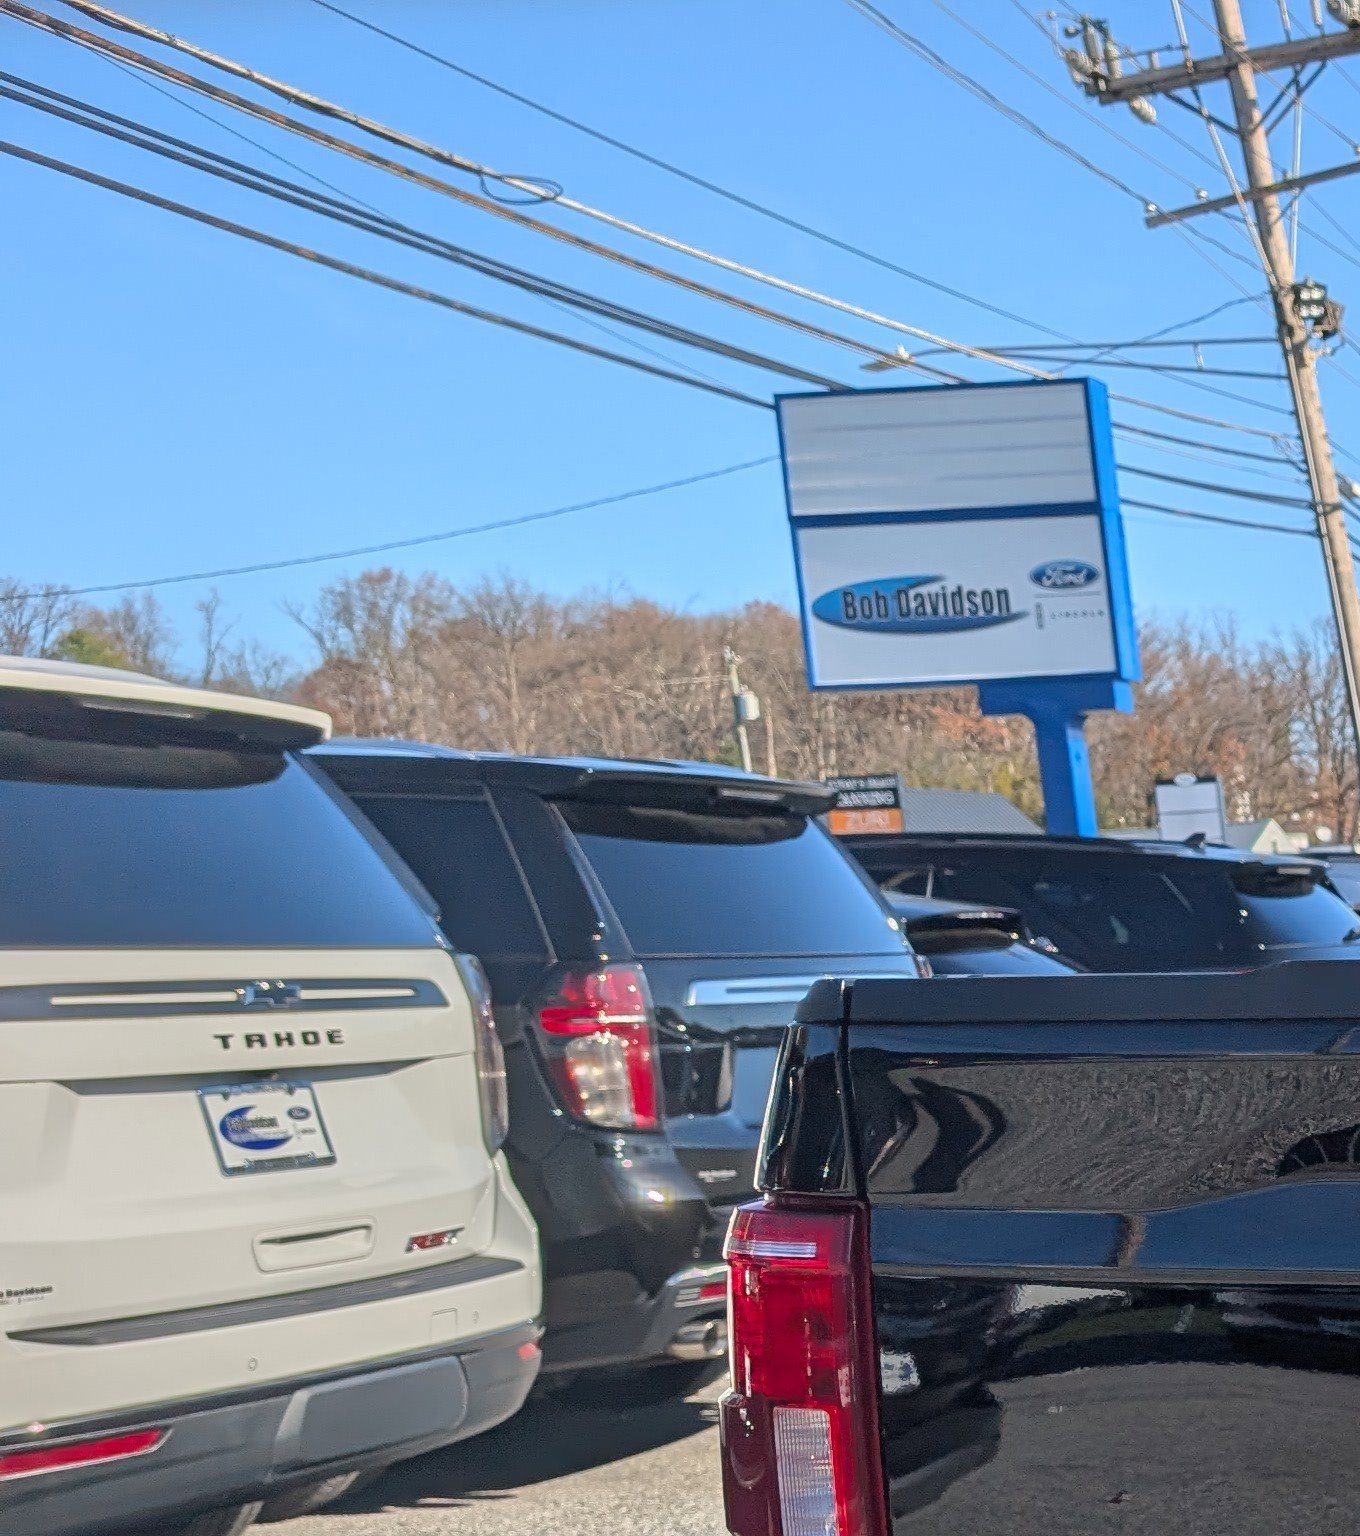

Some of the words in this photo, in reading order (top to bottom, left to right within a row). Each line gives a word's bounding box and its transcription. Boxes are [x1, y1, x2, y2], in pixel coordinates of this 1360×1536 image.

[843, 587, 889, 620] Bob
[897, 585, 1011, 618] Davidson
[213, 1028, 345, 1049] TAHOE
